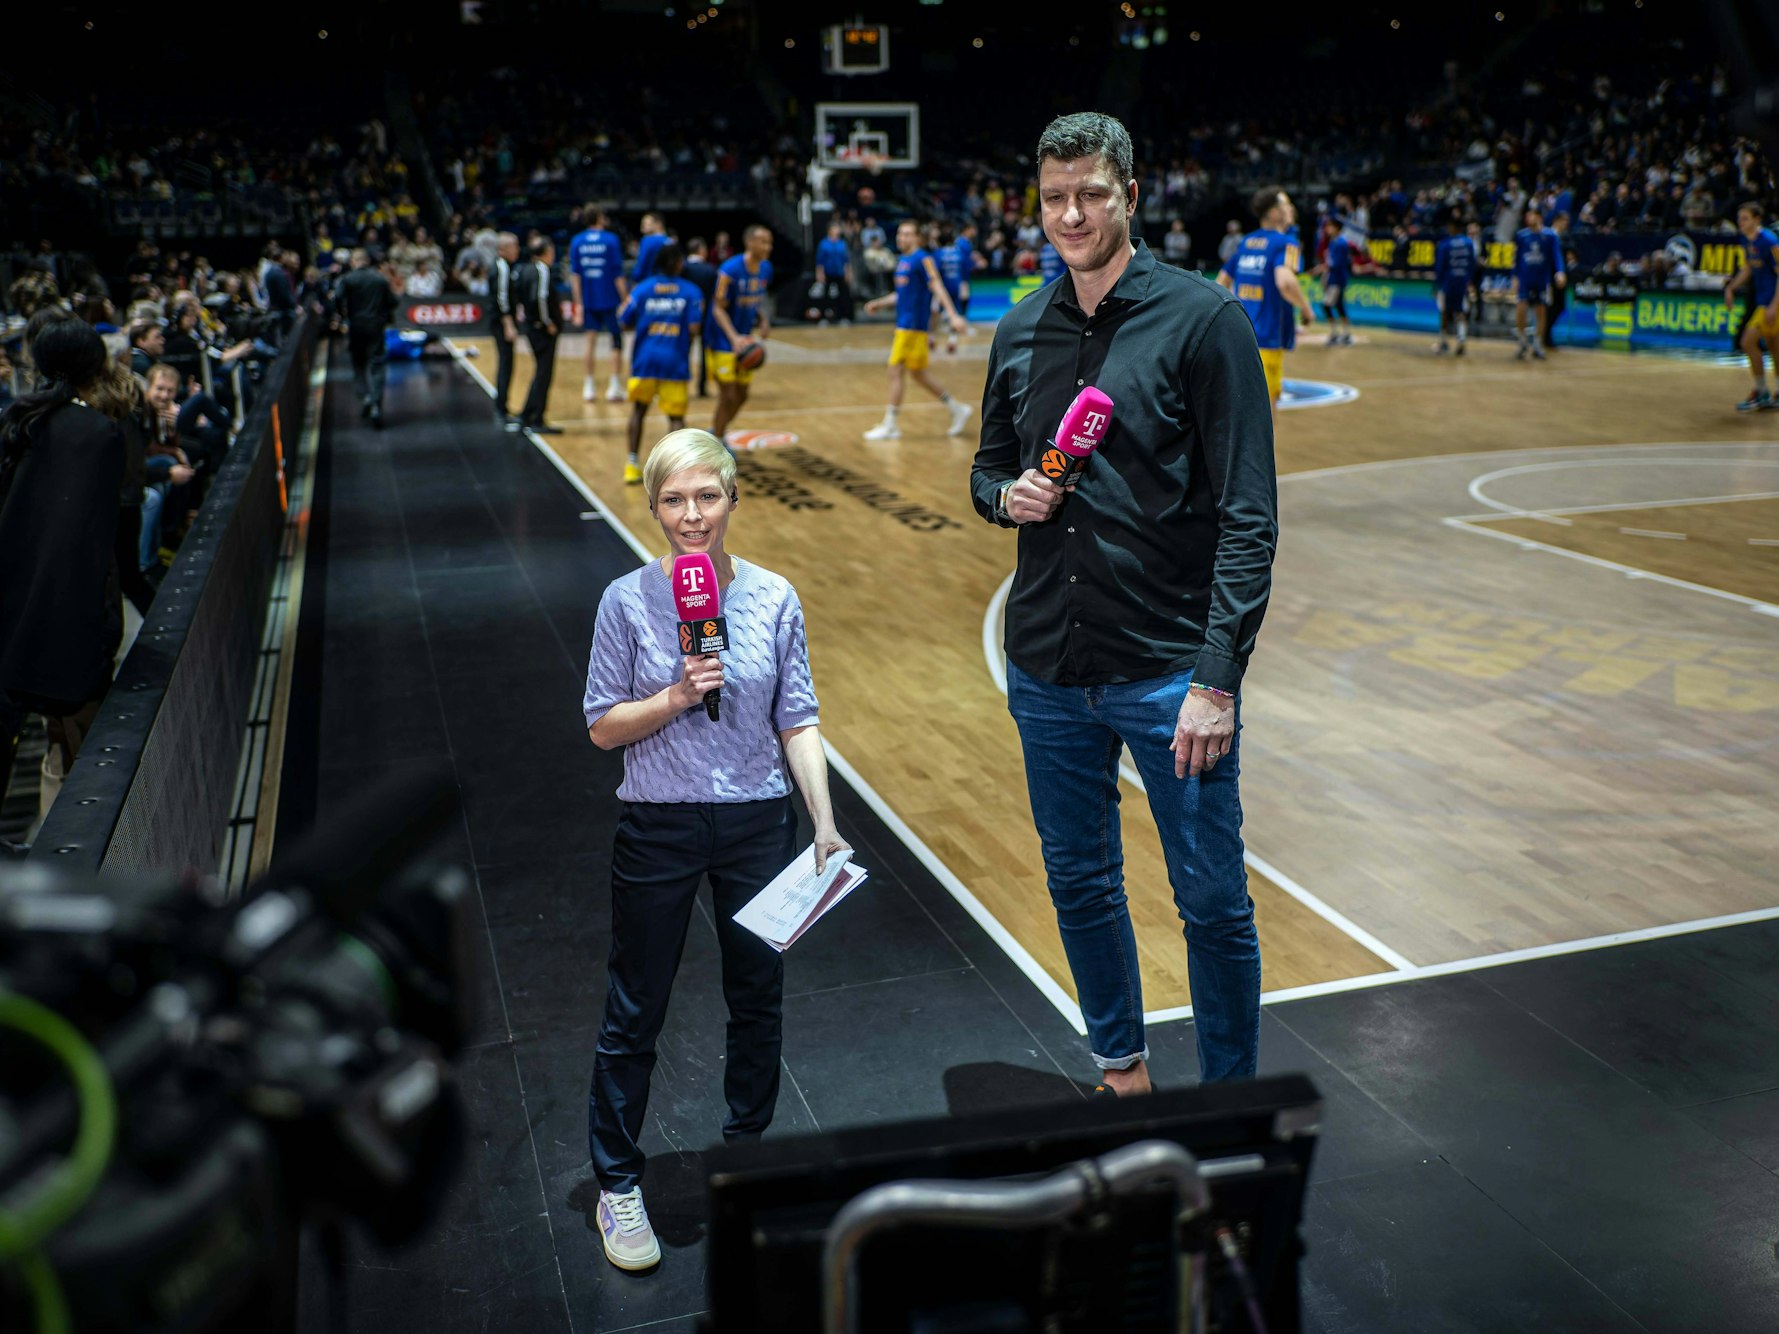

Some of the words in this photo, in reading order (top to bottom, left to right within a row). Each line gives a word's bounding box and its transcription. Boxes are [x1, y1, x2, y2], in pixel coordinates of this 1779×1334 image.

[1083, 411, 1106, 436] T
[1072, 440, 1092, 450] SPORT
[682, 567, 705, 593] T
[680, 593, 711, 603] MAGENTA
[686, 600, 707, 608] SPORT
[700, 635, 723, 643] TURKISH
